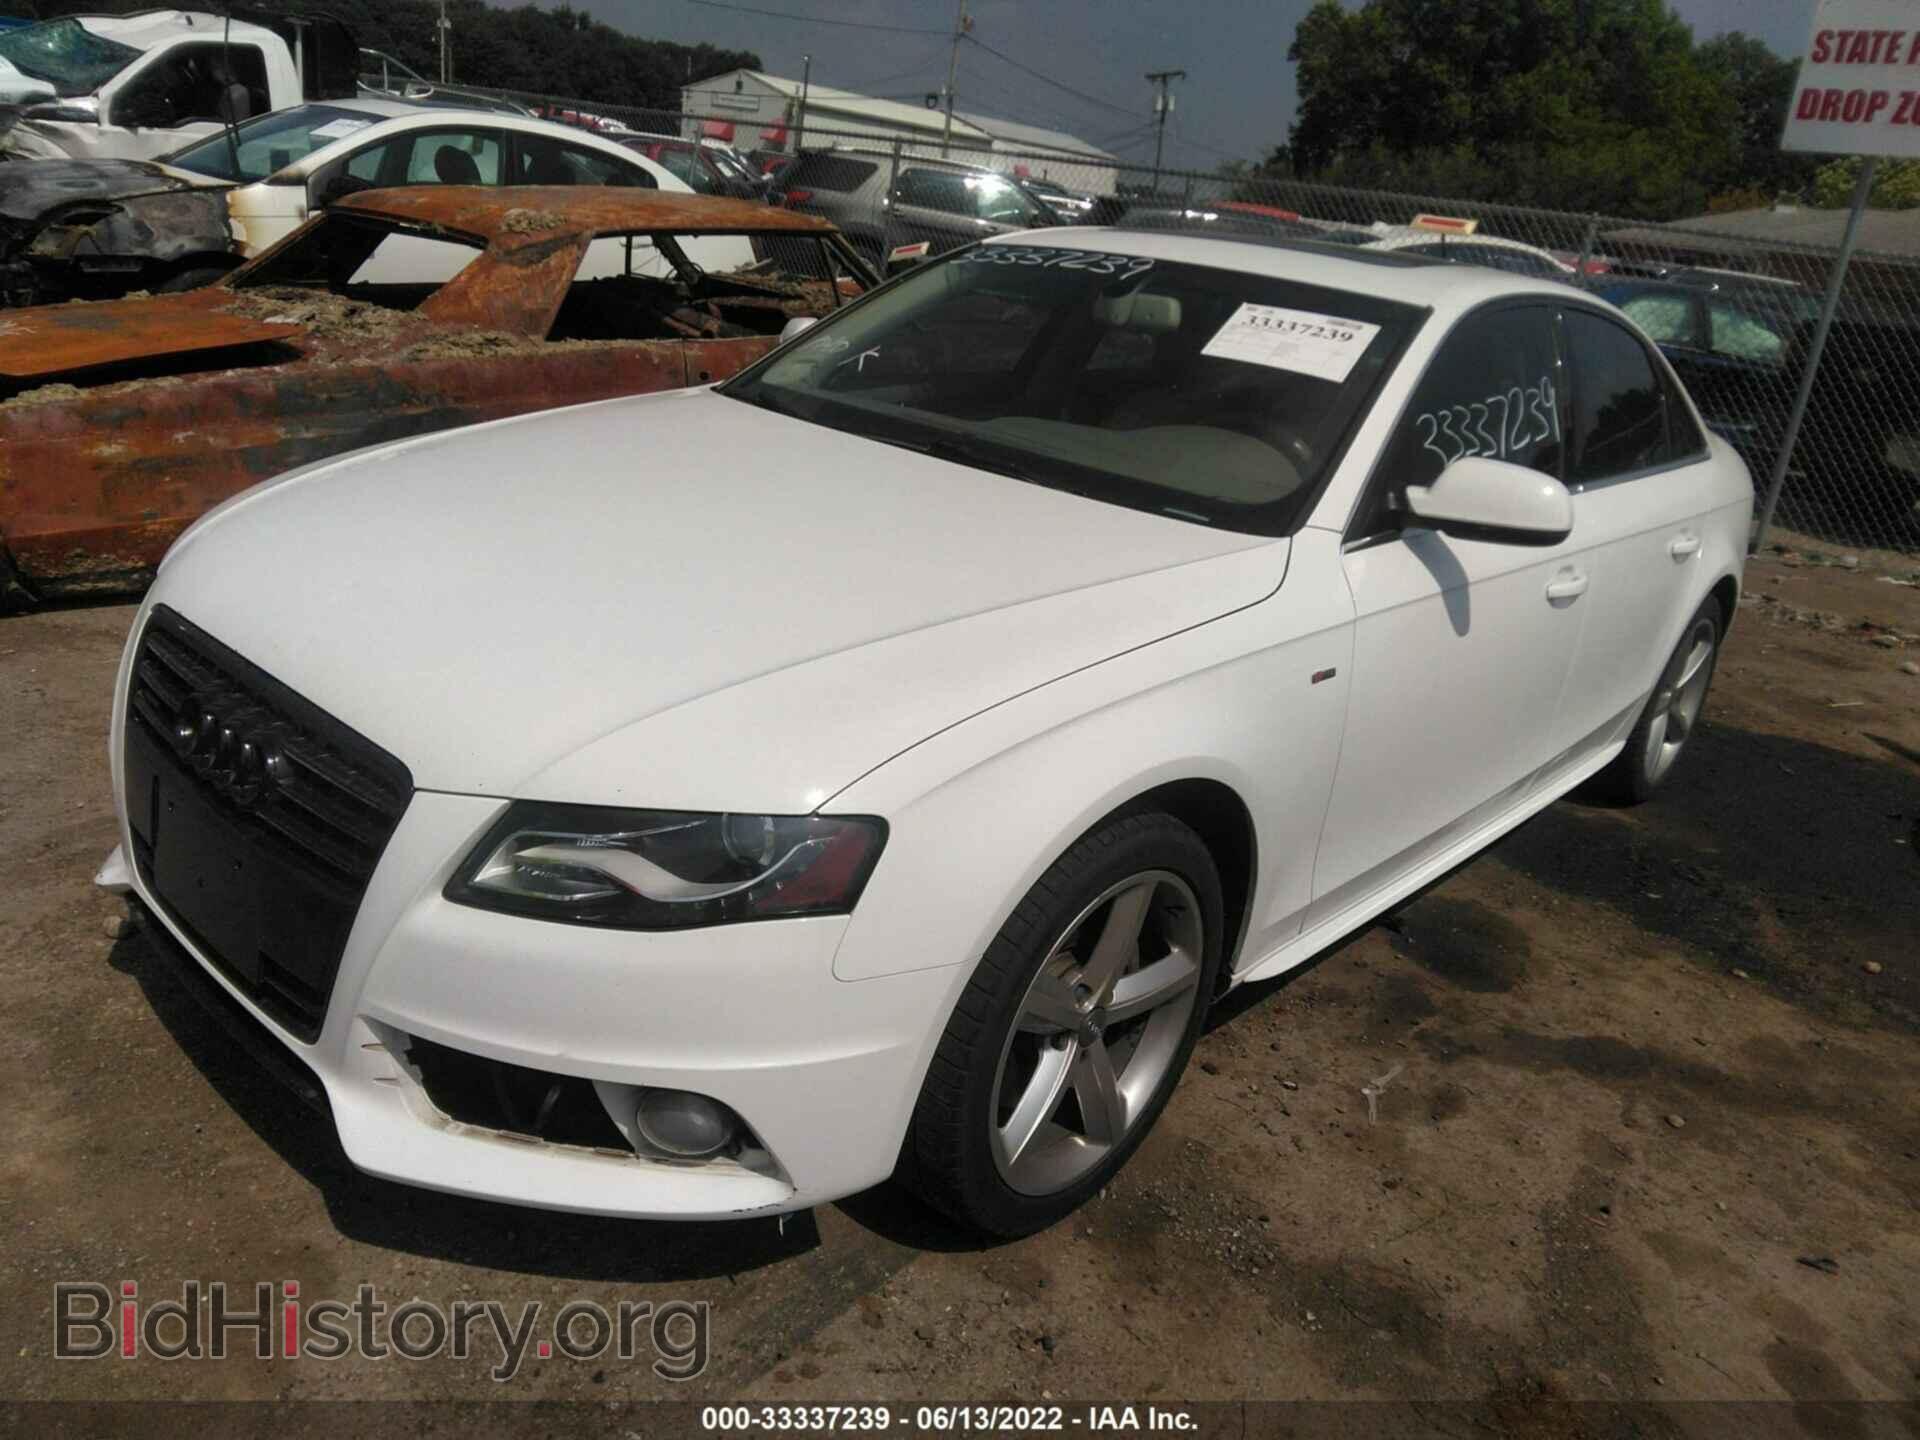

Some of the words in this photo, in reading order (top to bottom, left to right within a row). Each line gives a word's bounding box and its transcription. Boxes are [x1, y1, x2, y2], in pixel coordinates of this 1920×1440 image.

[1811, 29, 1906, 65] STATE
[1796, 87, 1890, 123] DROP
[1241, 314, 1354, 343] 33337239
